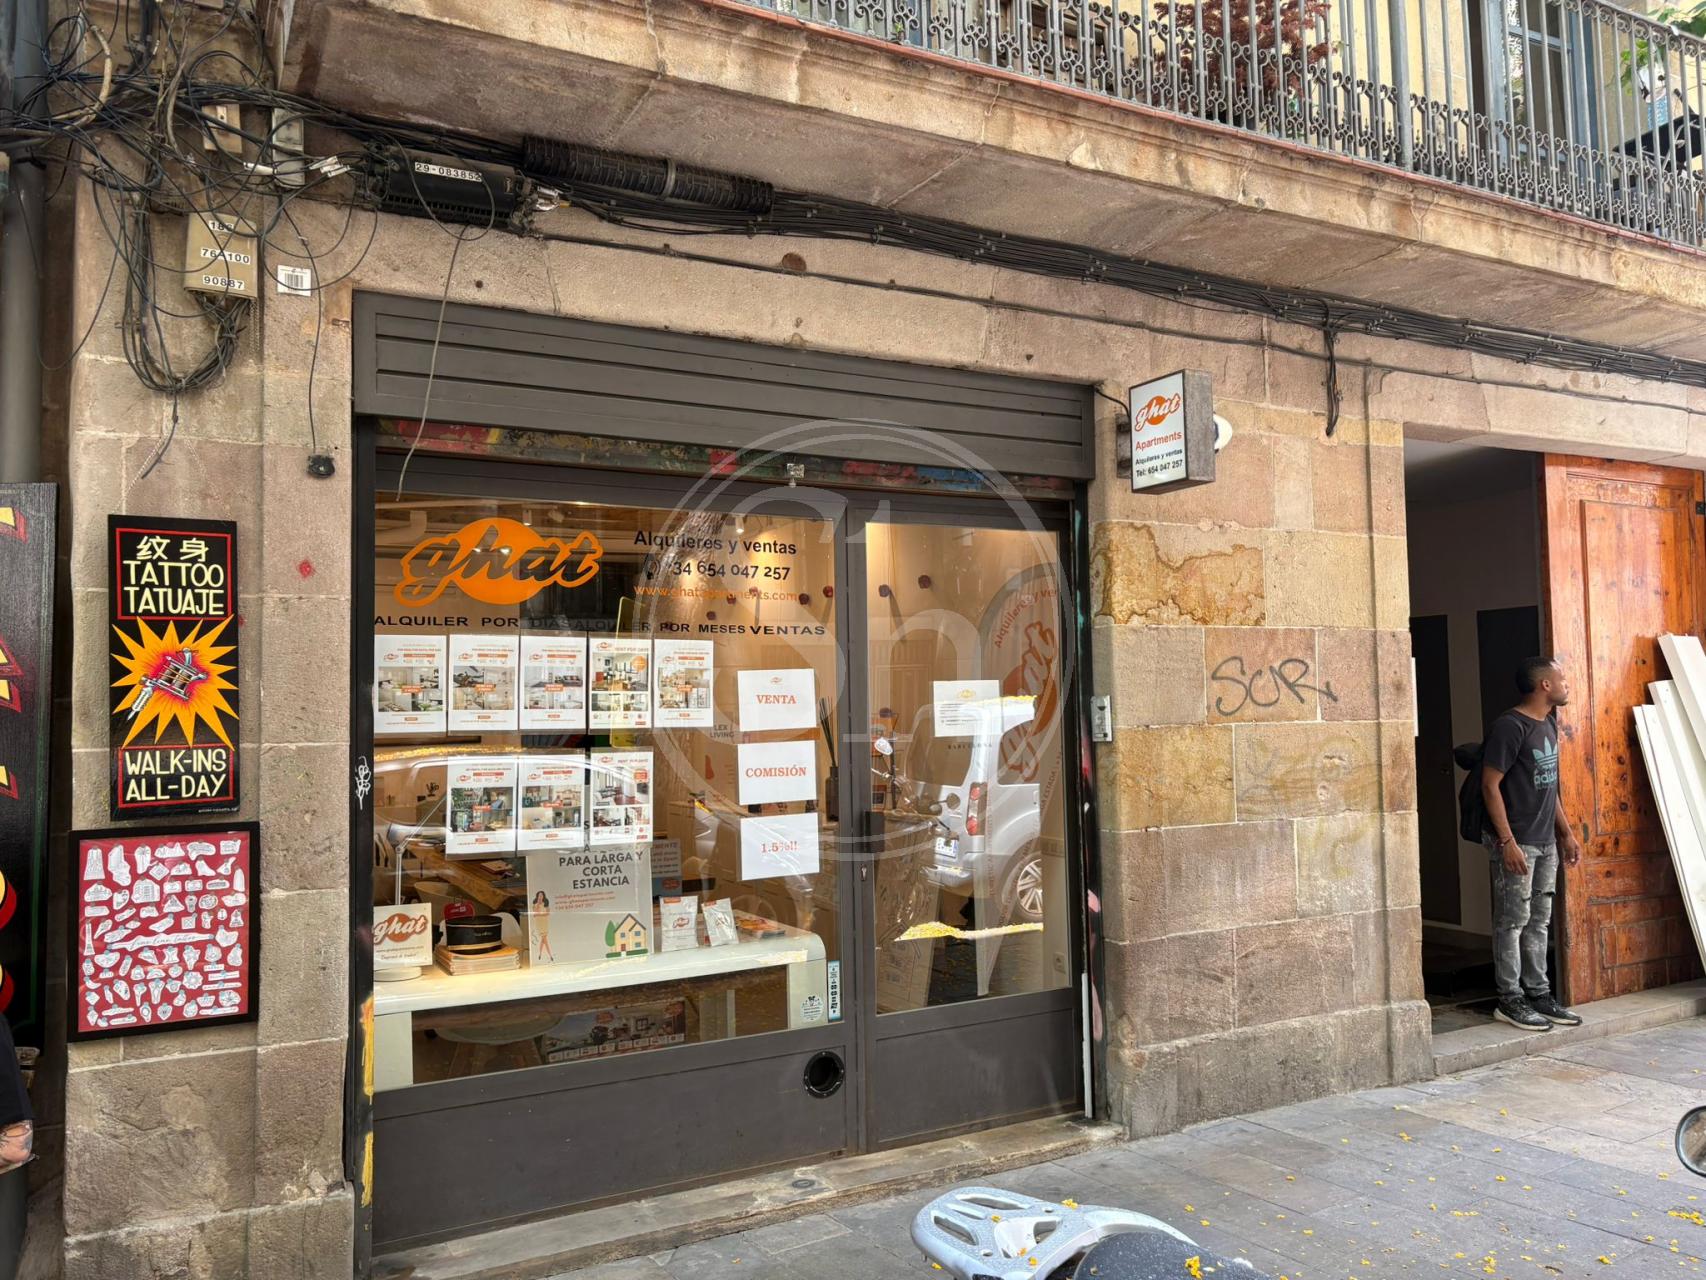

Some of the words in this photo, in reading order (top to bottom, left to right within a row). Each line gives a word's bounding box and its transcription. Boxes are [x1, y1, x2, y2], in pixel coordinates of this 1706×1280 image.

[415, 162, 481, 181] 29-083852
[203, 276, 243, 289] 90887
[1135, 393, 1181, 432] ghat
[1135, 431, 1183, 452] Apartments
[1165, 448, 1183, 458] ventas
[1147, 465, 1158, 474] 654
[1159, 462, 1171, 471] 047
[1171, 459, 1183, 469] 257
[136, 535, 210, 562] 纹身
[728, 539, 738, 554] y
[743, 539, 797, 555] ventas
[122, 559, 225, 588] TATTOO
[394, 520, 604, 608] ghat
[696, 560, 726, 577] 654
[730, 564, 759, 579] 047
[763, 566, 791, 581] 257
[123, 586, 225, 616] TATUAJE
[373, 615, 469, 627] ALQUILER
[481, 617, 519, 627] POR
[660, 623, 690, 632] POR
[699, 624, 746, 634] MESES
[750, 625, 826, 635] VENTAS
[756, 694, 797, 705] VENTA
[124, 748, 227, 776] WALK-INS
[745, 764, 807, 778] COMISIÓN
[125, 772, 227, 801] ALL-DAY
[559, 856, 591, 867] PARA
[594, 852, 634, 864] LARGA
[637, 851, 643, 861] Y
[582, 864, 623, 877] CORTA
[572, 876, 630, 890] ESTANCIA
[373, 913, 428, 945] ghat
